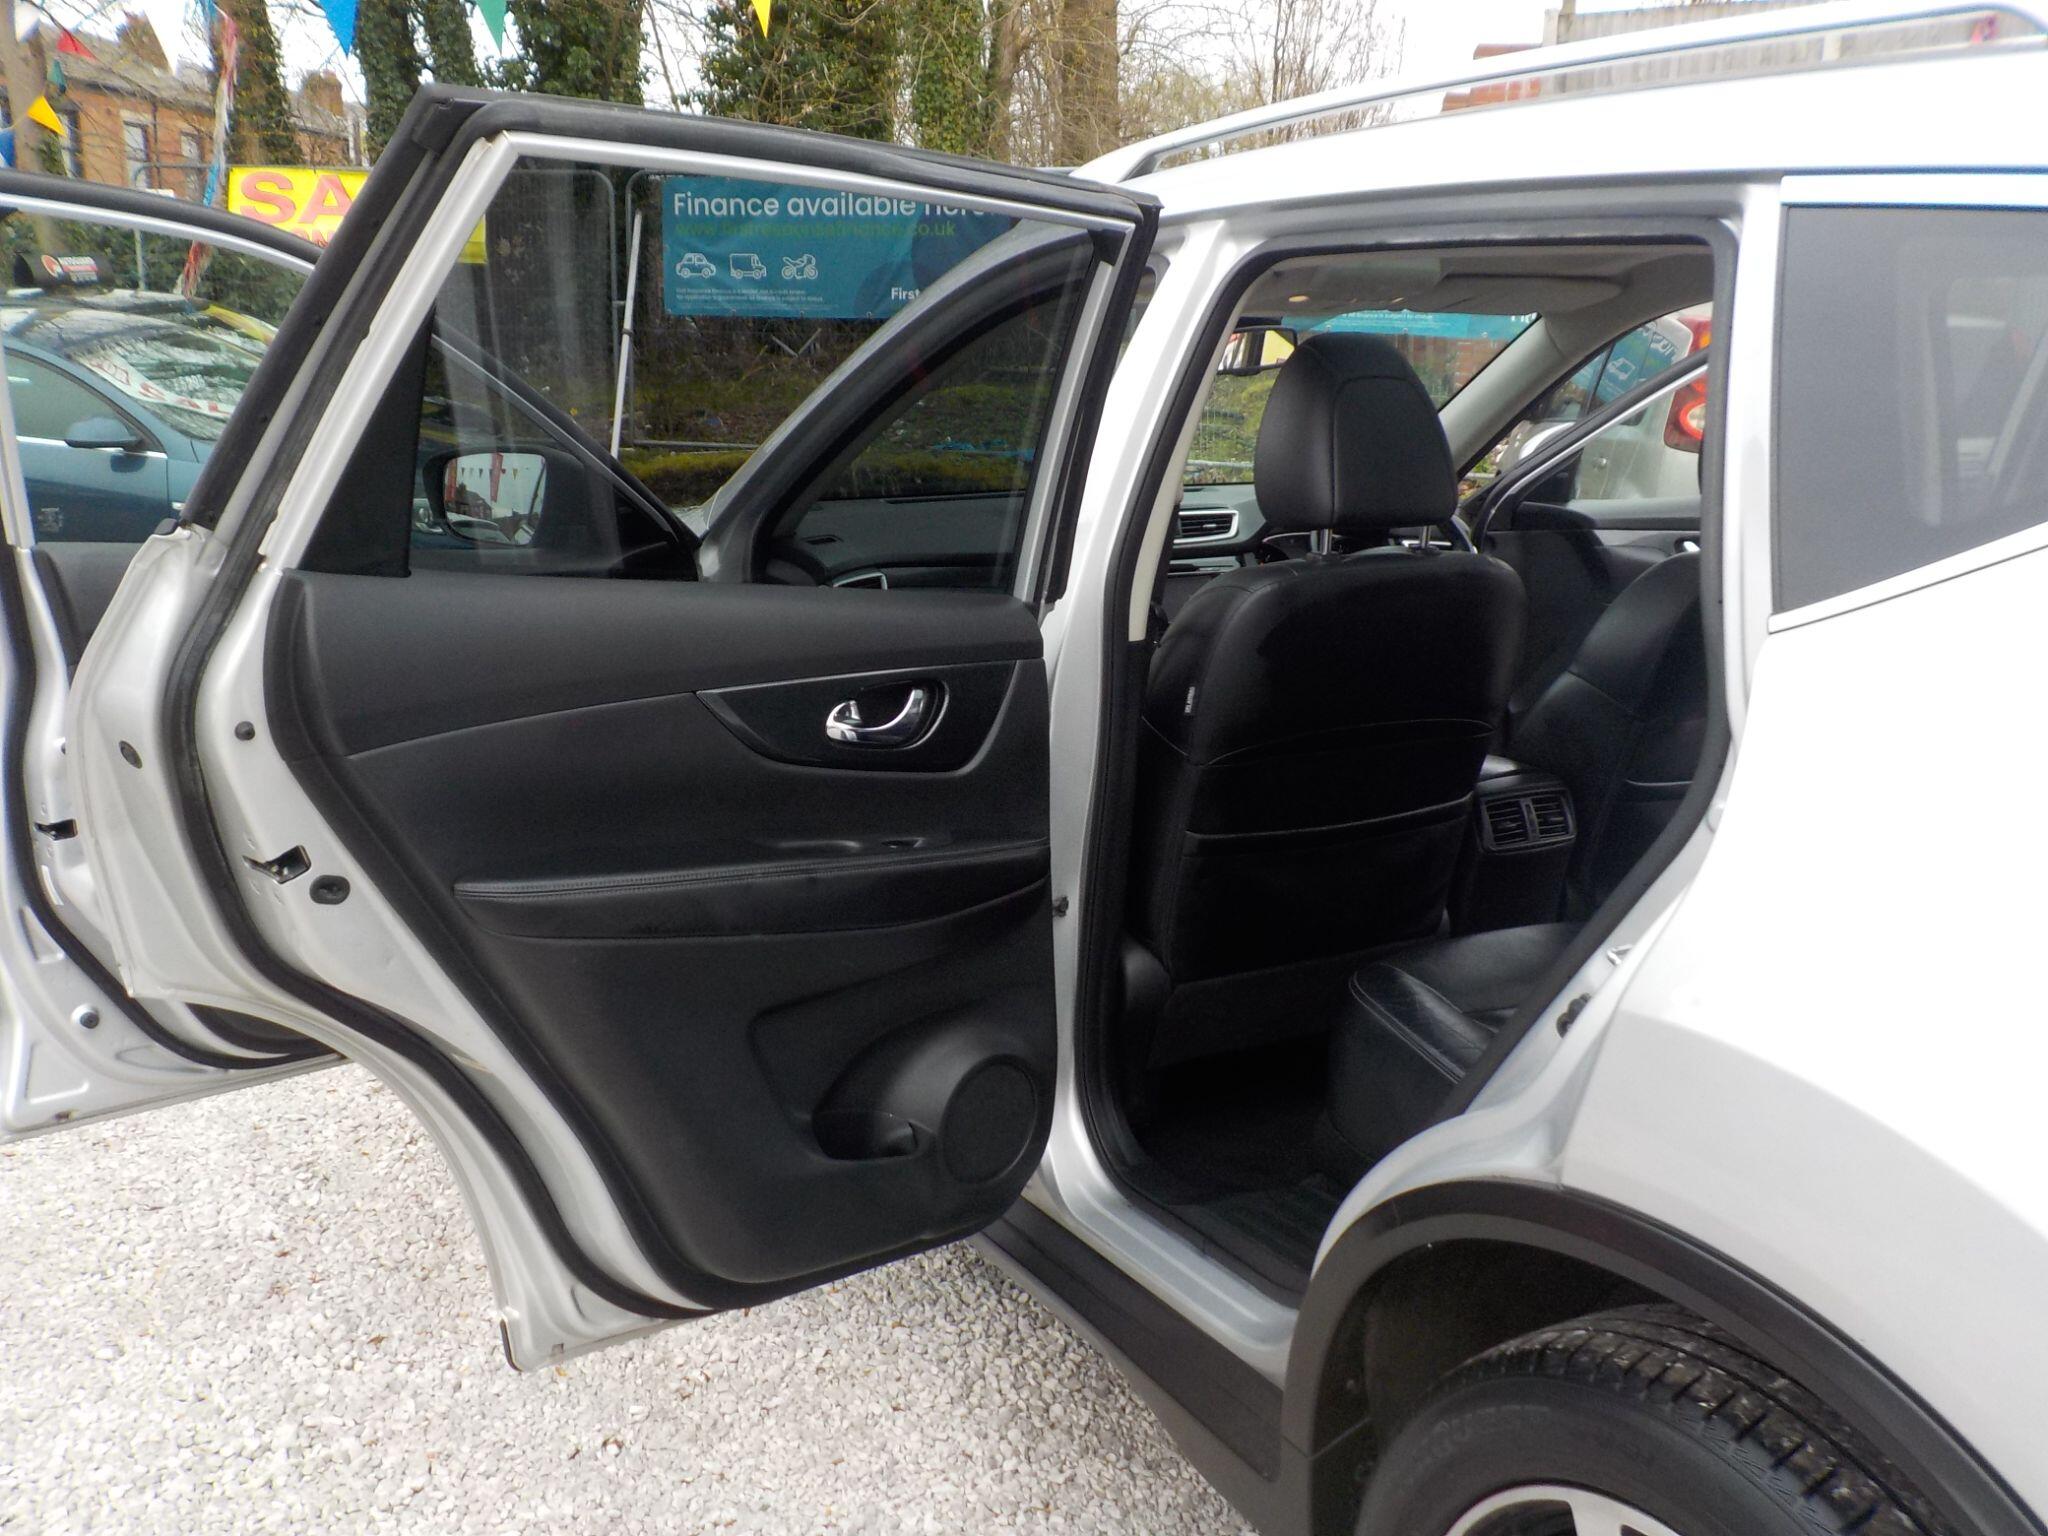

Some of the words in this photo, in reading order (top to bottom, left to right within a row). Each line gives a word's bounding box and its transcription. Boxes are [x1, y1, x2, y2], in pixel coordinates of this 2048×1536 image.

[674, 192, 779, 216] Finance
[787, 193, 916, 216] available
[891, 287, 920, 300] First
